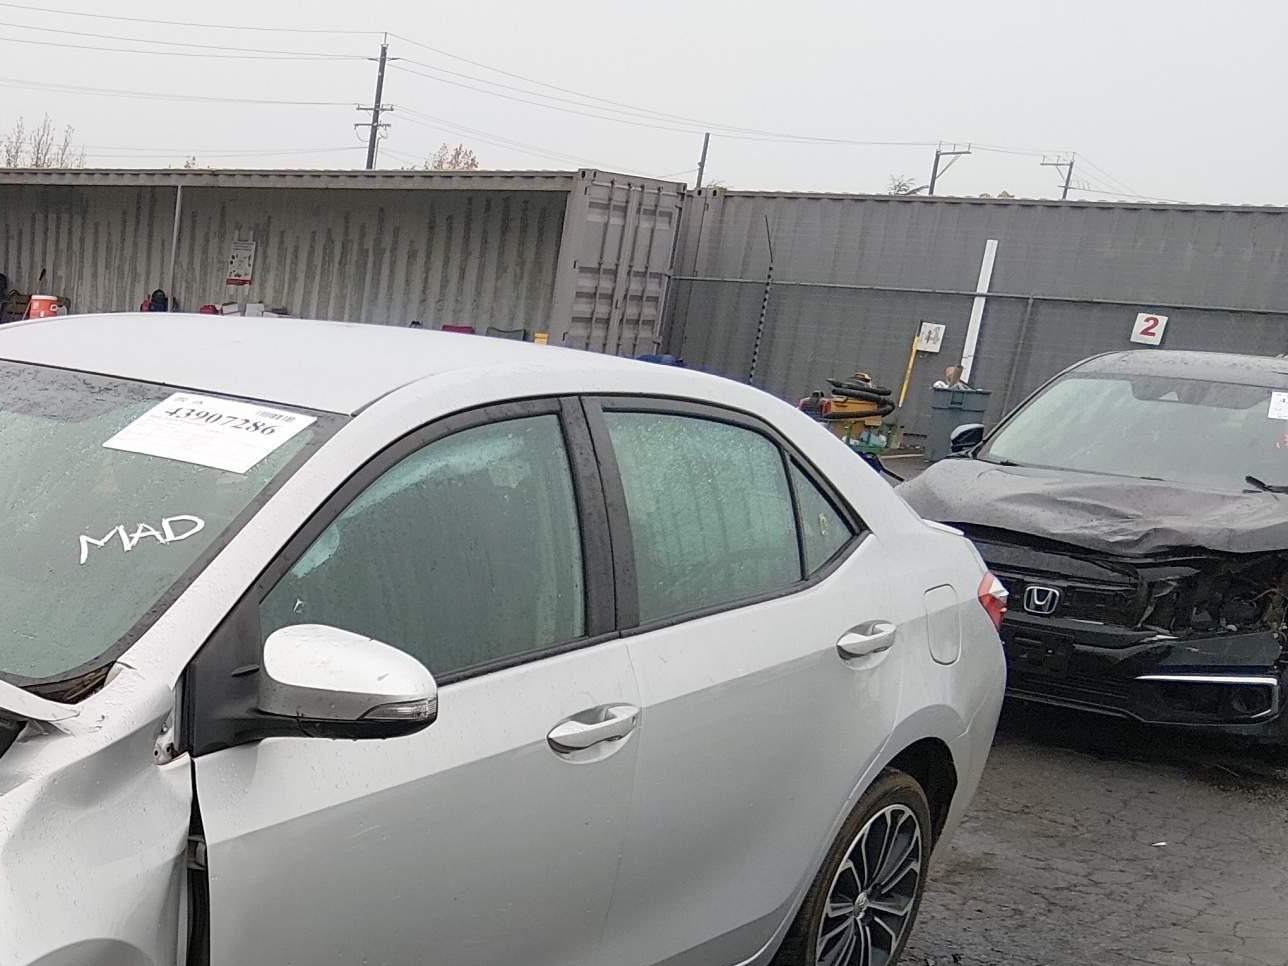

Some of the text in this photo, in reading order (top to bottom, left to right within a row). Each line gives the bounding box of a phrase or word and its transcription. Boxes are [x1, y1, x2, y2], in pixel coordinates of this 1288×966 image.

[1139, 316, 1159, 336] 2
[165, 407, 279, 435] 43907286
[79, 514, 205, 565] MAD
